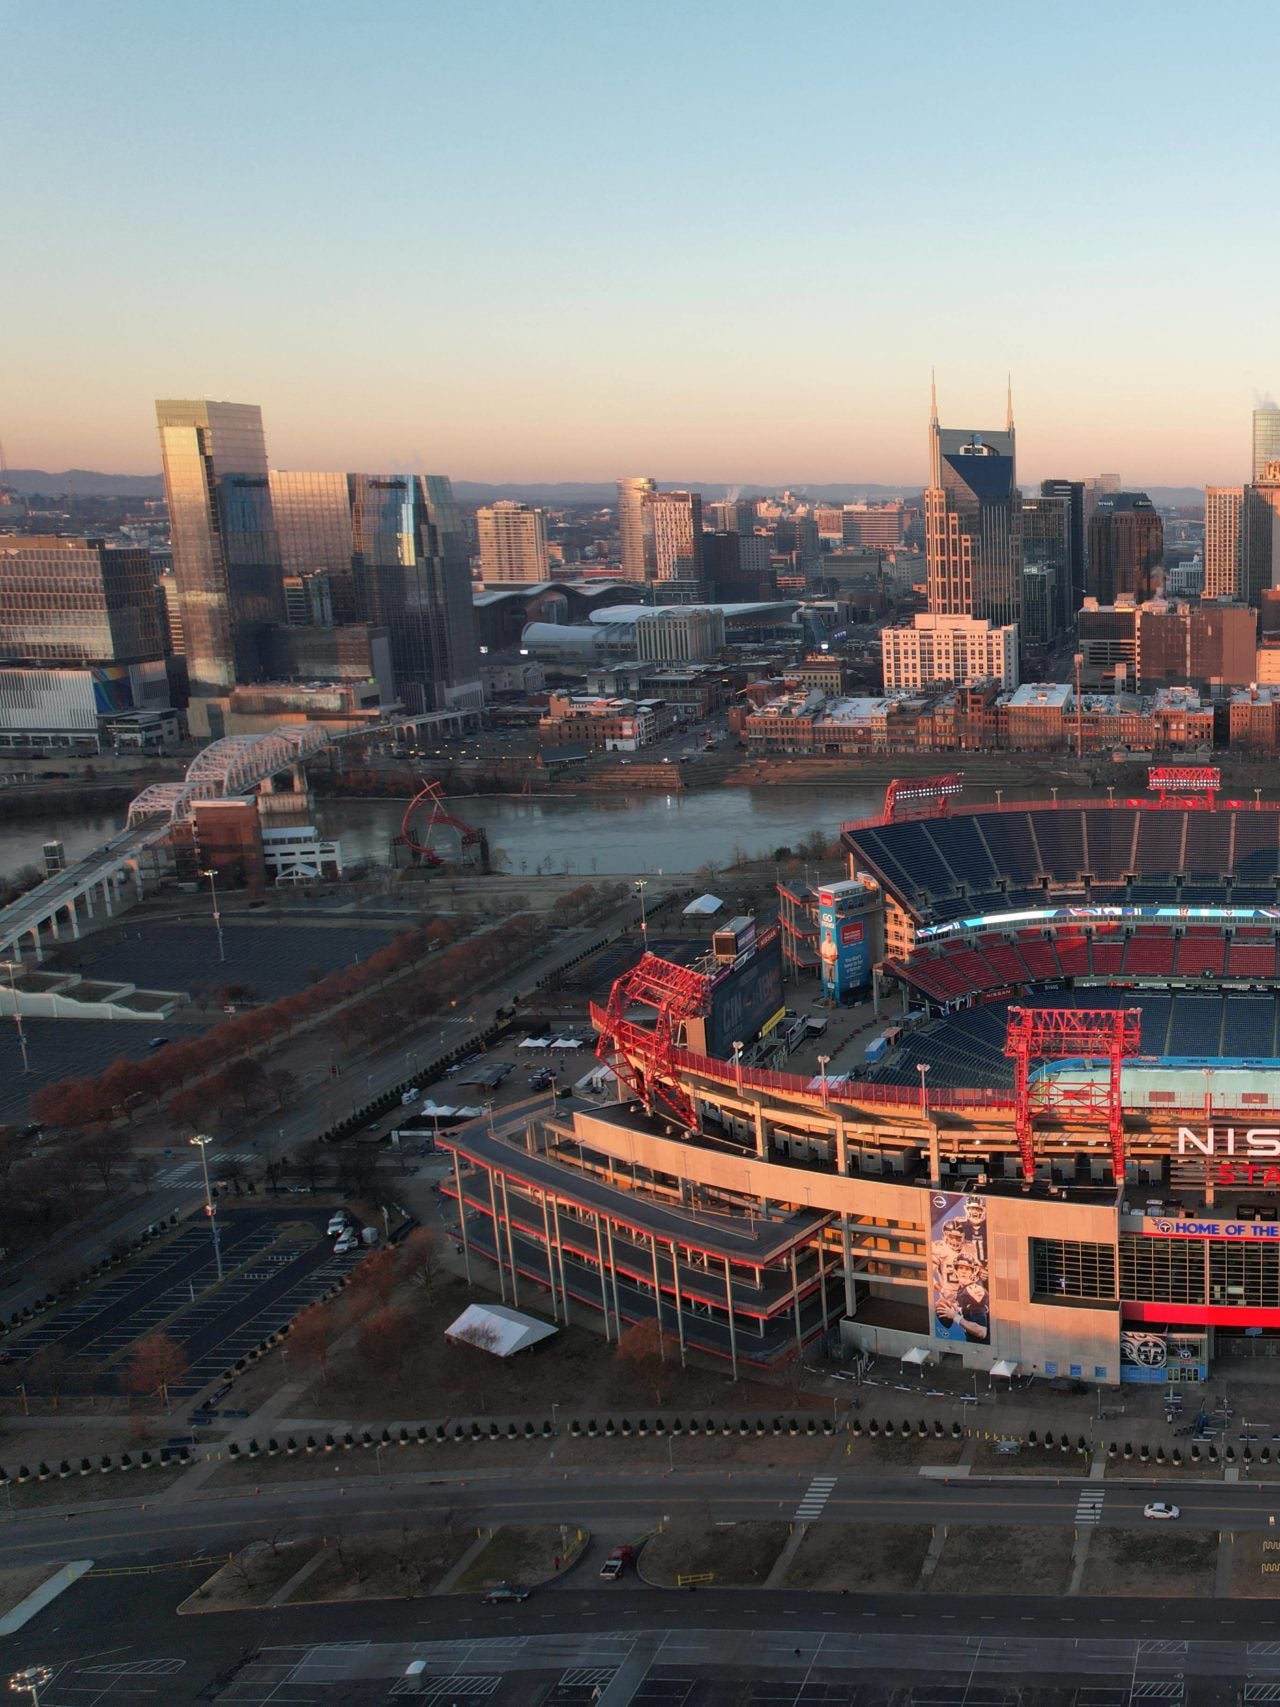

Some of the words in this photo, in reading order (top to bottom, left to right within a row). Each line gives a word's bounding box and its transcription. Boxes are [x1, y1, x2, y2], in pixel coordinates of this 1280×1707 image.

[985, 990, 1011, 998] NISSAN
[1175, 1222, 1221, 1235] HOME
[1225, 1224, 1246, 1236] OF
[1251, 1225, 1279, 1237] THE
